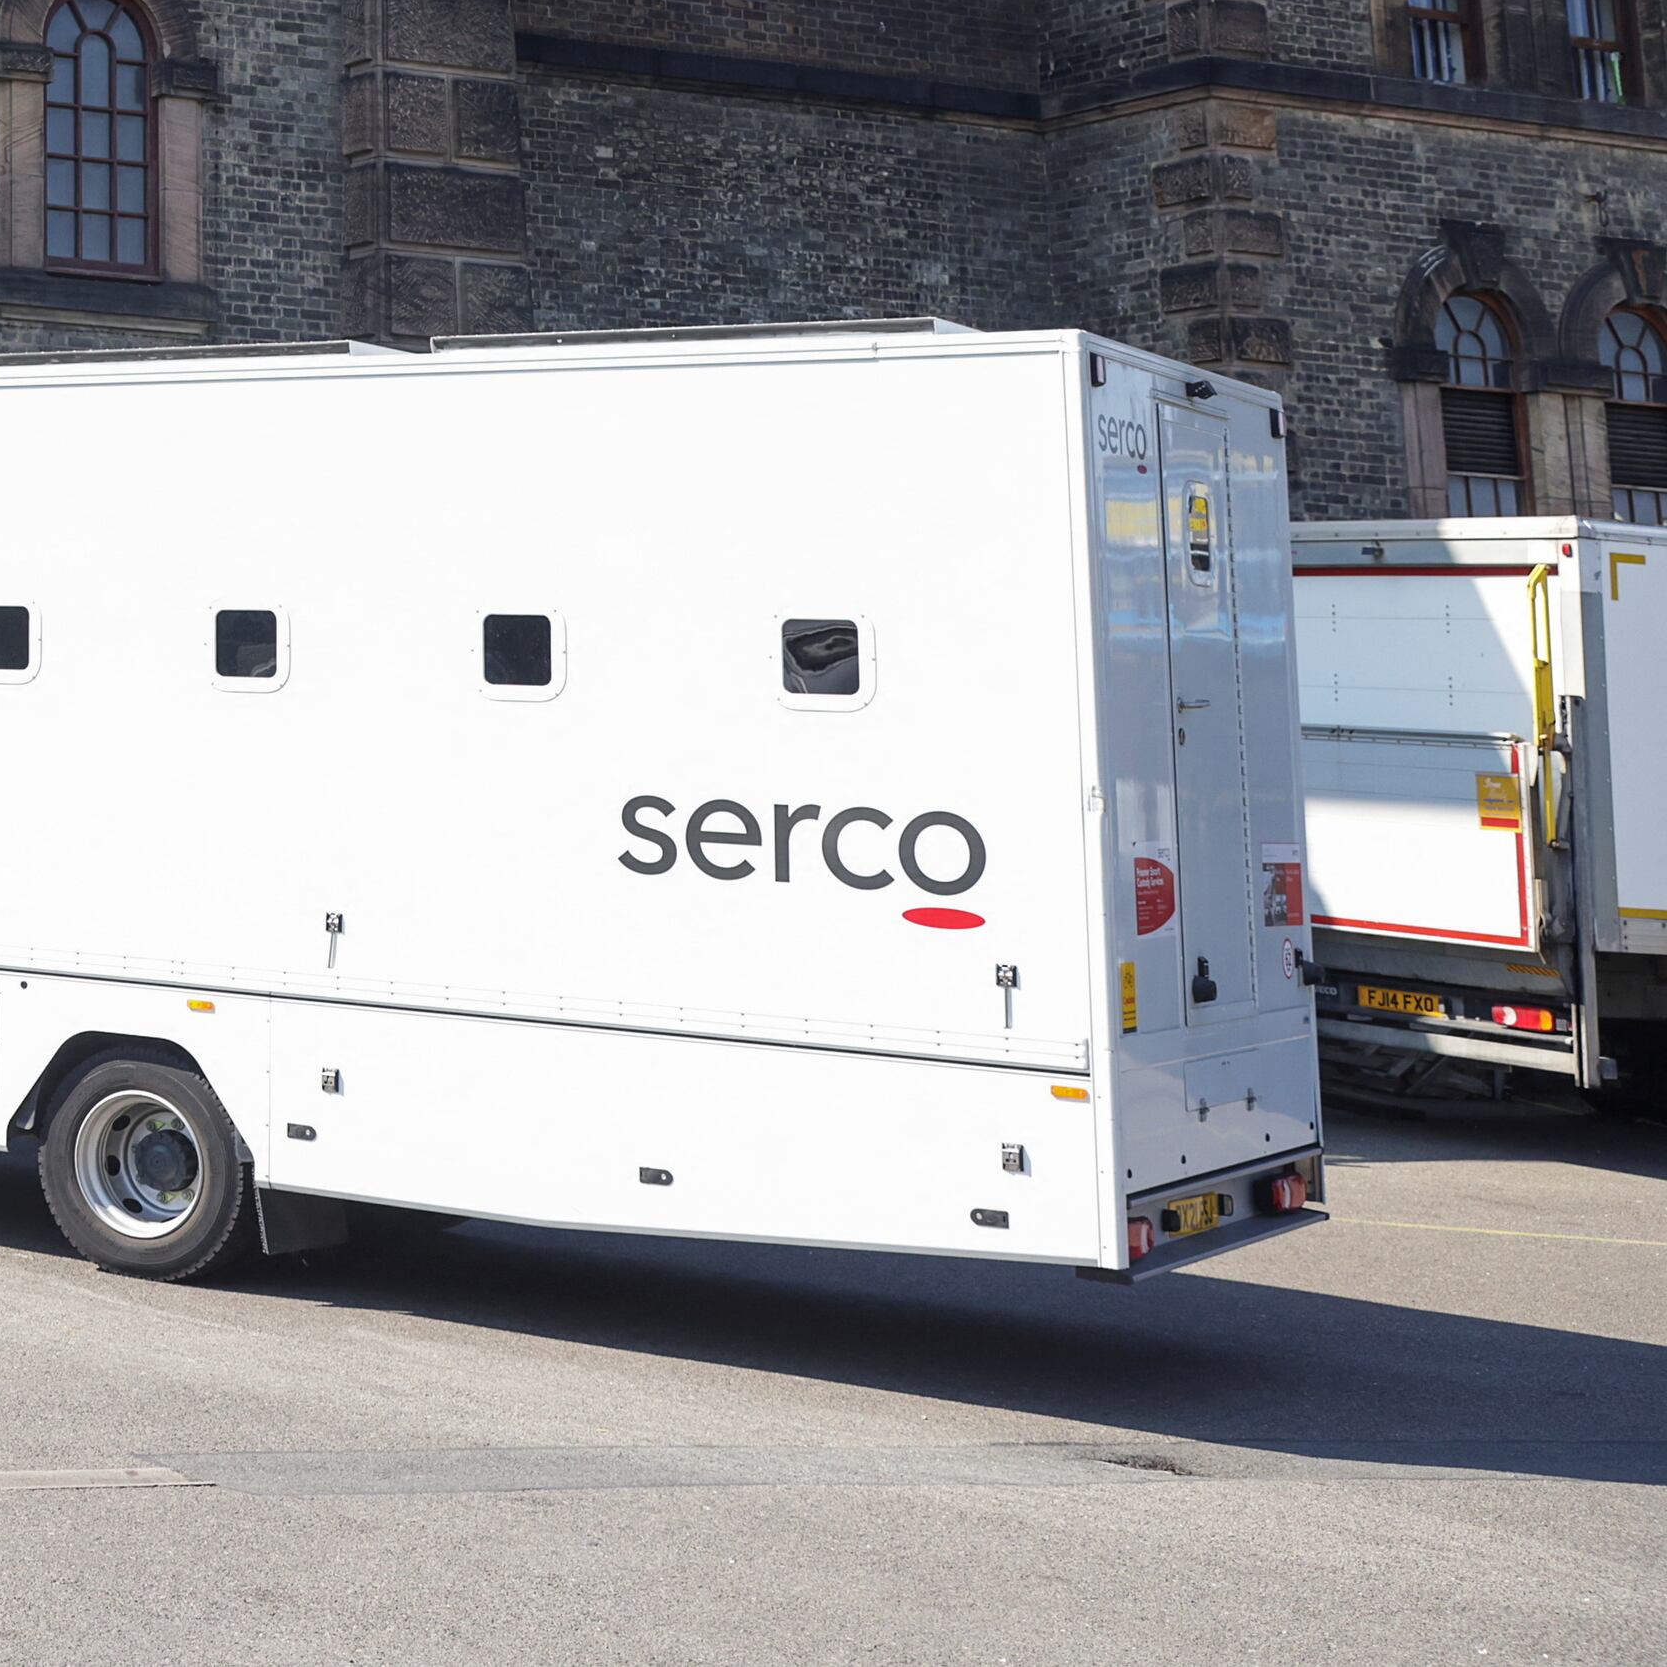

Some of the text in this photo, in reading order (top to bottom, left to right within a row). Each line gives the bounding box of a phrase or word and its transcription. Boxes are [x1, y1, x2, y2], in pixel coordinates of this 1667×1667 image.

[1098, 413, 1147, 460] serco
[618, 794, 987, 897] serco
[1368, 989, 1398, 1008] FJ14
